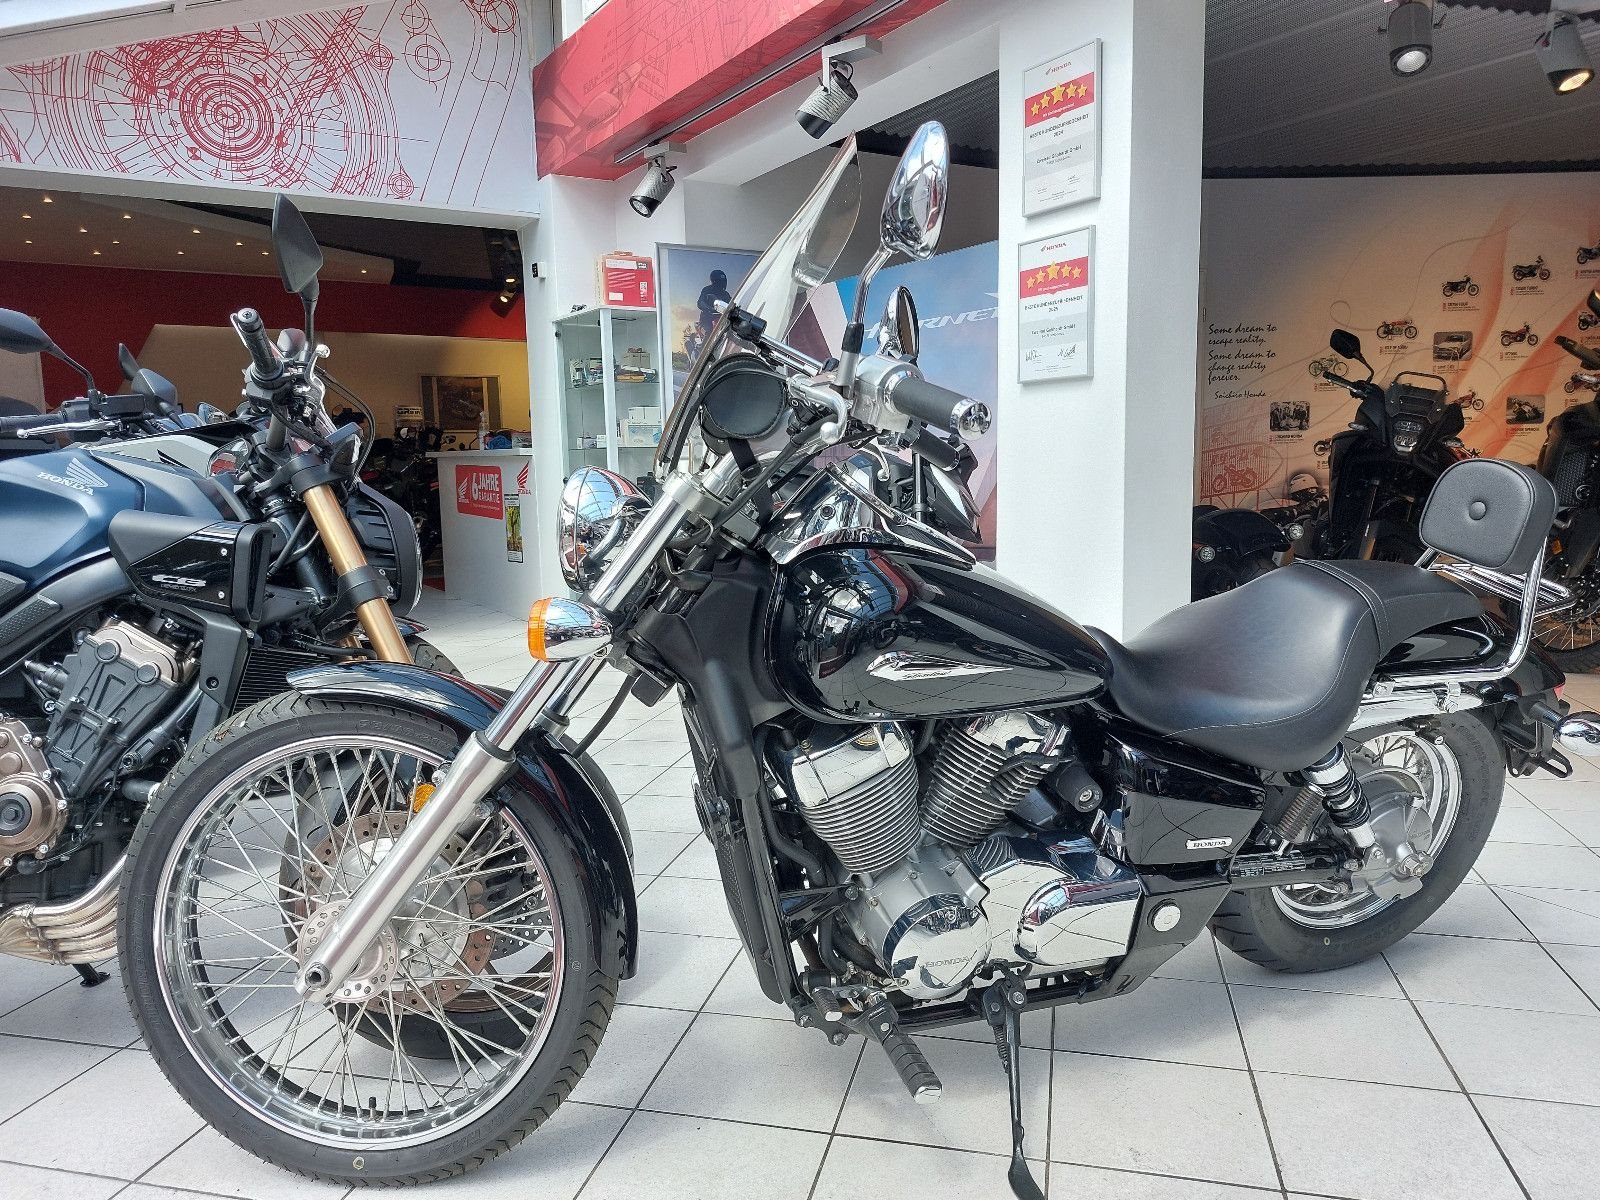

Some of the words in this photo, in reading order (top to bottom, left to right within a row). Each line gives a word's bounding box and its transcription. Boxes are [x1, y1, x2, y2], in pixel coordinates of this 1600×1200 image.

[1208, 323, 1233, 335] Some
[1234, 322, 1264, 334] dream
[1265, 323, 1277, 333] to
[1208, 338, 1233, 347] escape
[1208, 349, 1232, 361] Some
[1234, 348, 1264, 359] dream
[1266, 349, 1276, 359] to
[1207, 361, 1235, 374] change
[1237, 360, 1267, 372] reality
[36, 471, 94, 496] HONDA
[471, 472, 479, 501] 6
[478, 472, 500, 492] JAHRE
[1192, 840, 1227, 848] HONDA
[925, 955, 971, 968] HONDA
